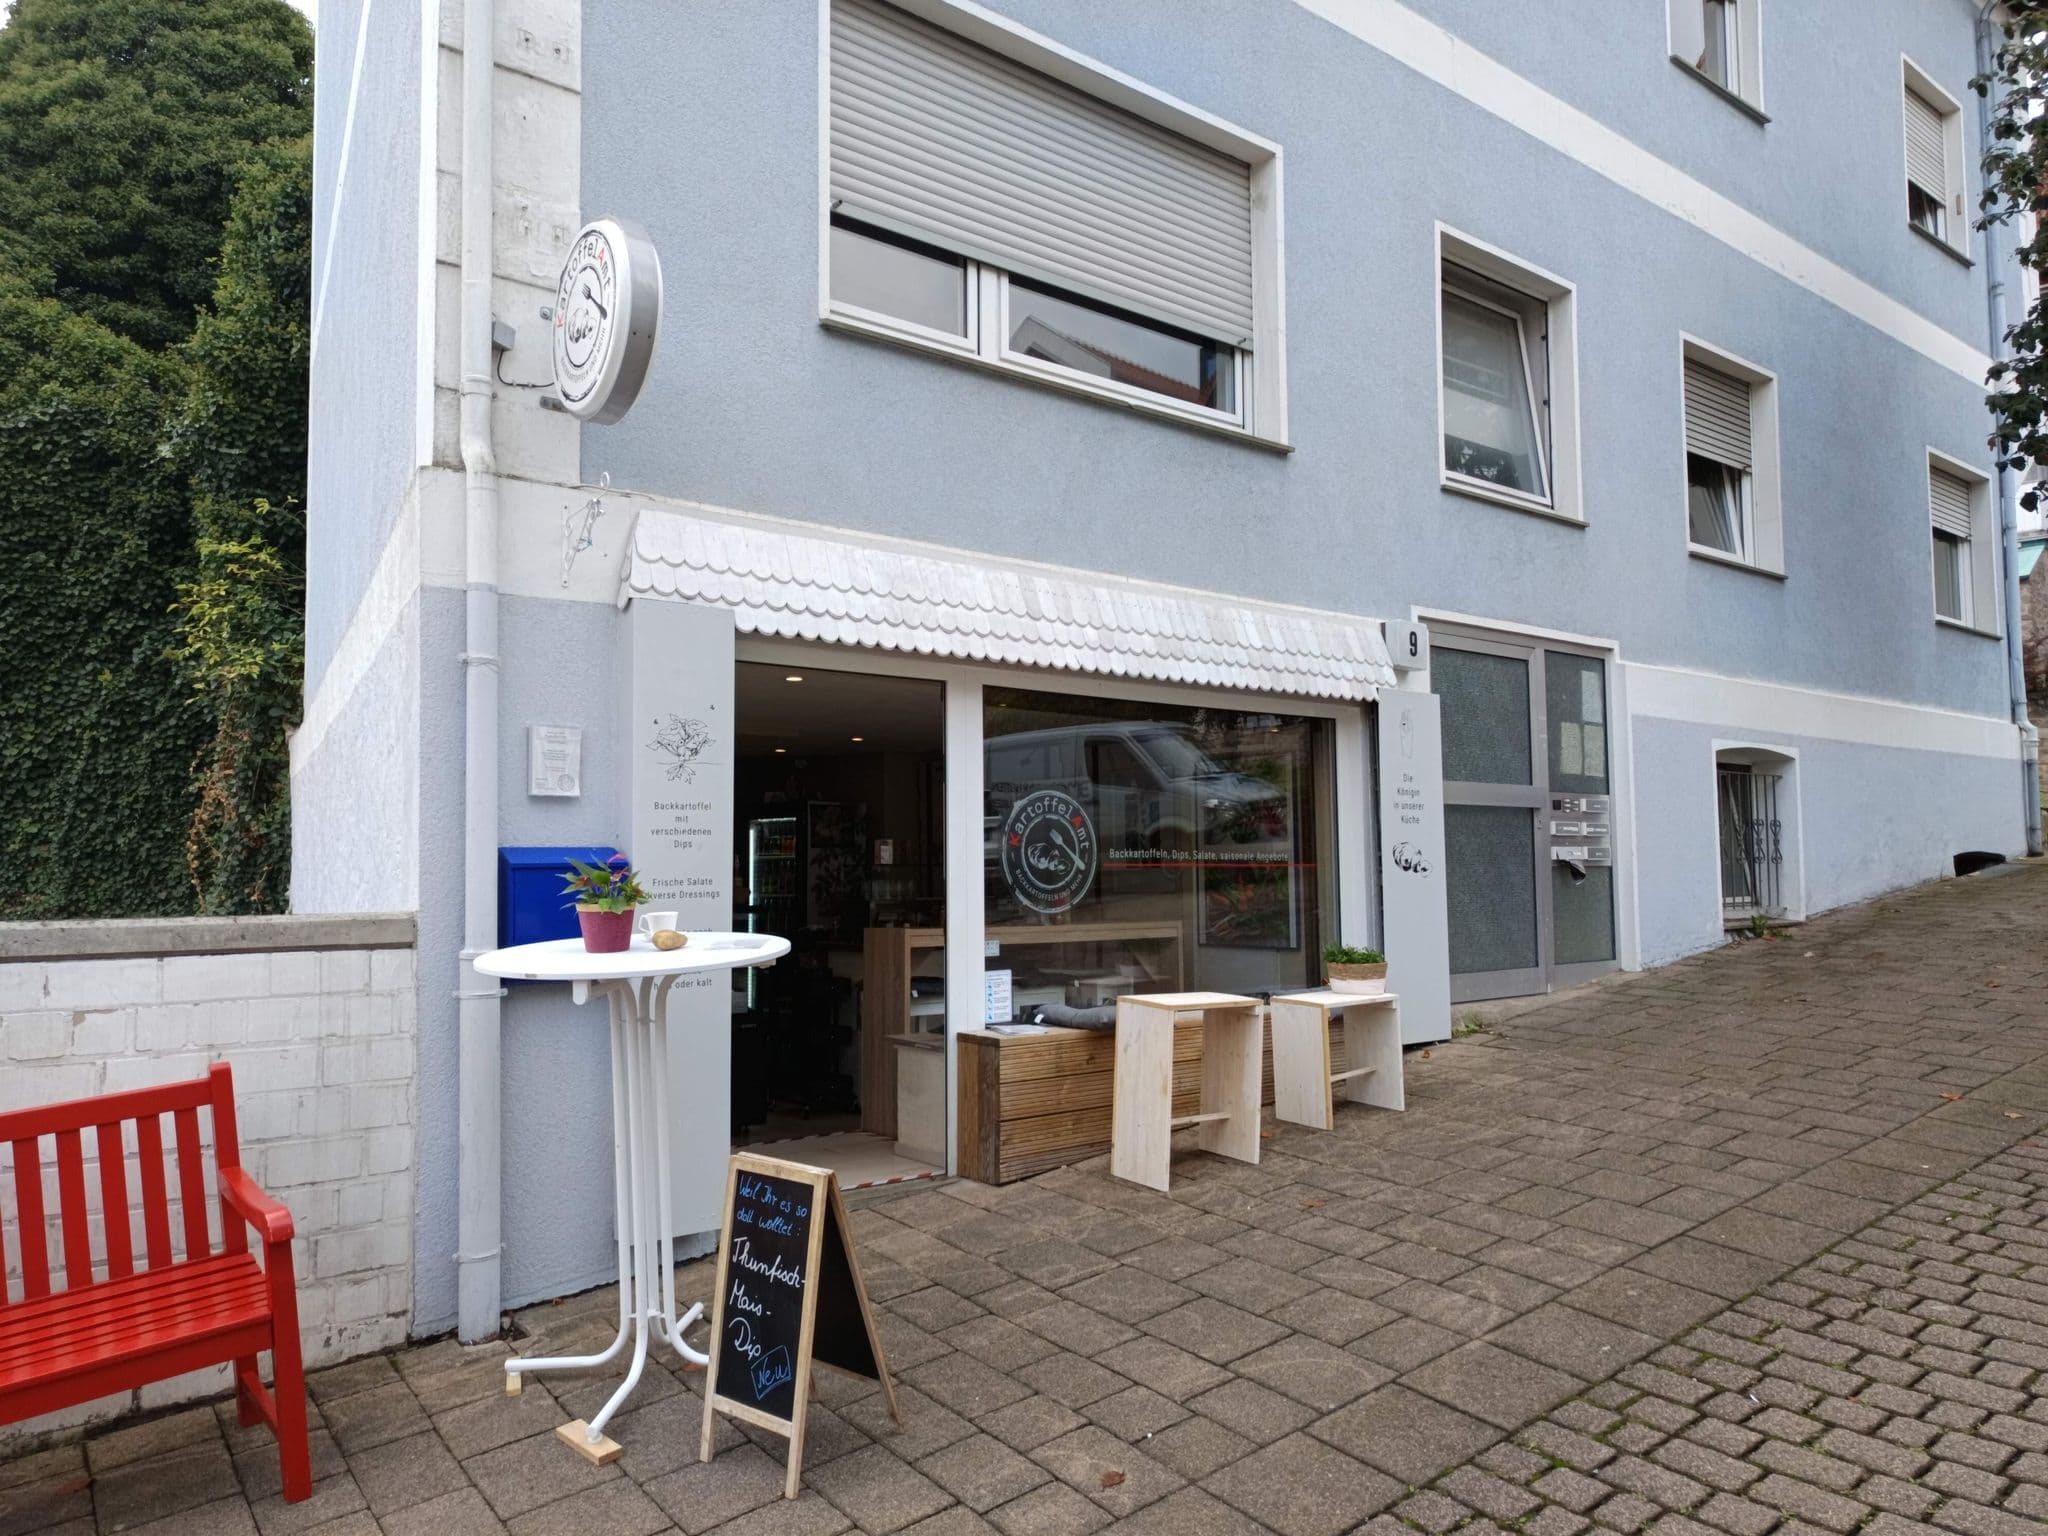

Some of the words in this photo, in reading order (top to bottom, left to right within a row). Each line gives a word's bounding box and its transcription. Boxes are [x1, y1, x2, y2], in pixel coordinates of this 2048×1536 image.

[557, 239, 611, 328] KartoffelAmt
[1410, 631, 1417, 656] 9
[1402, 773, 1413, 782] Die
[654, 801, 712, 811] Backkartoffel
[1401, 802, 1424, 810] unserer
[675, 815, 689, 823] mit
[1008, 796, 1090, 848] KartoffelAmt
[650, 827, 712, 836] verschiedenen
[673, 840, 693, 849] Dips
[1109, 848, 1170, 859] Backkartoffeln,
[652, 878, 684, 887] Frische
[687, 877, 713, 886] Salate
[679, 890, 720, 899] Dressings
[675, 979, 694, 988] oder
[696, 978, 713, 987] kalt
[740, 1175, 762, 1199] Weil
[780, 1200, 791, 1213] es
[795, 1205, 808, 1217] so
[732, 1236, 806, 1288] Thunfisch-
[728, 1317, 762, 1360] Dip
